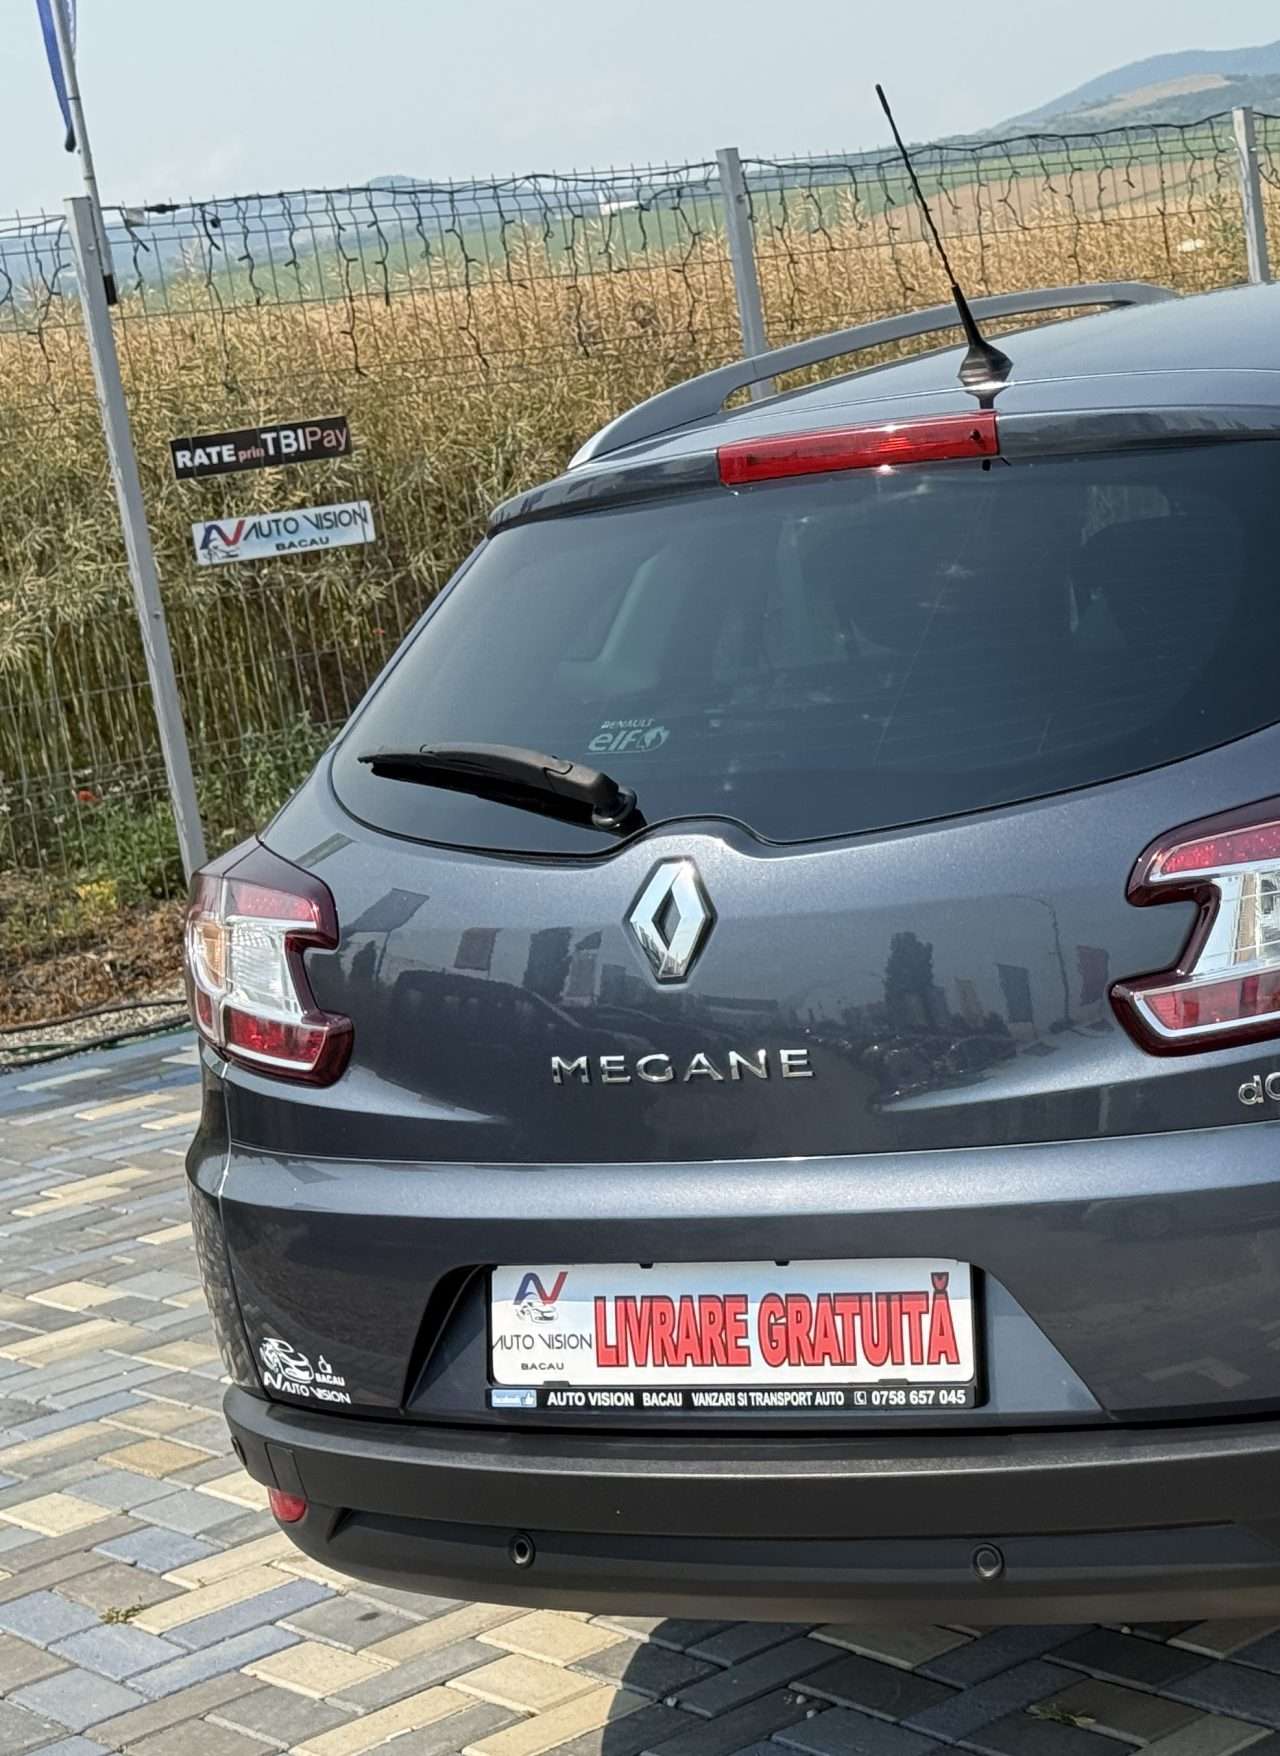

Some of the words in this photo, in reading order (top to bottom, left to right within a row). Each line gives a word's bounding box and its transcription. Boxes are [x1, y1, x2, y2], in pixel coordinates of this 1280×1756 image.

[175, 444, 237, 469] RATE
[238, 446, 265, 463] prin
[243, 516, 300, 541] AUTO
[303, 506, 368, 531] VISION
[275, 536, 330, 551] BACAU
[550, 1048, 815, 1084] MEGANE
[593, 1294, 752, 1368] LIVRARE
[492, 1334, 535, 1351] AUTO
[538, 1333, 593, 1350] VISION
[520, 1362, 566, 1371] BACAU
[547, 1391, 586, 1407] AUTO
[588, 1391, 634, 1407] VISION
[643, 1391, 683, 1407] BACAU
[691, 1391, 736, 1406] VANZARI
[737, 1391, 748, 1406] SI
[750, 1391, 812, 1406] TRANSPORT
[814, 1391, 845, 1406] AUTO
[871, 1389, 906, 1405] 0758
[909, 1389, 935, 1405] 657
[938, 1389, 966, 1405] 045
